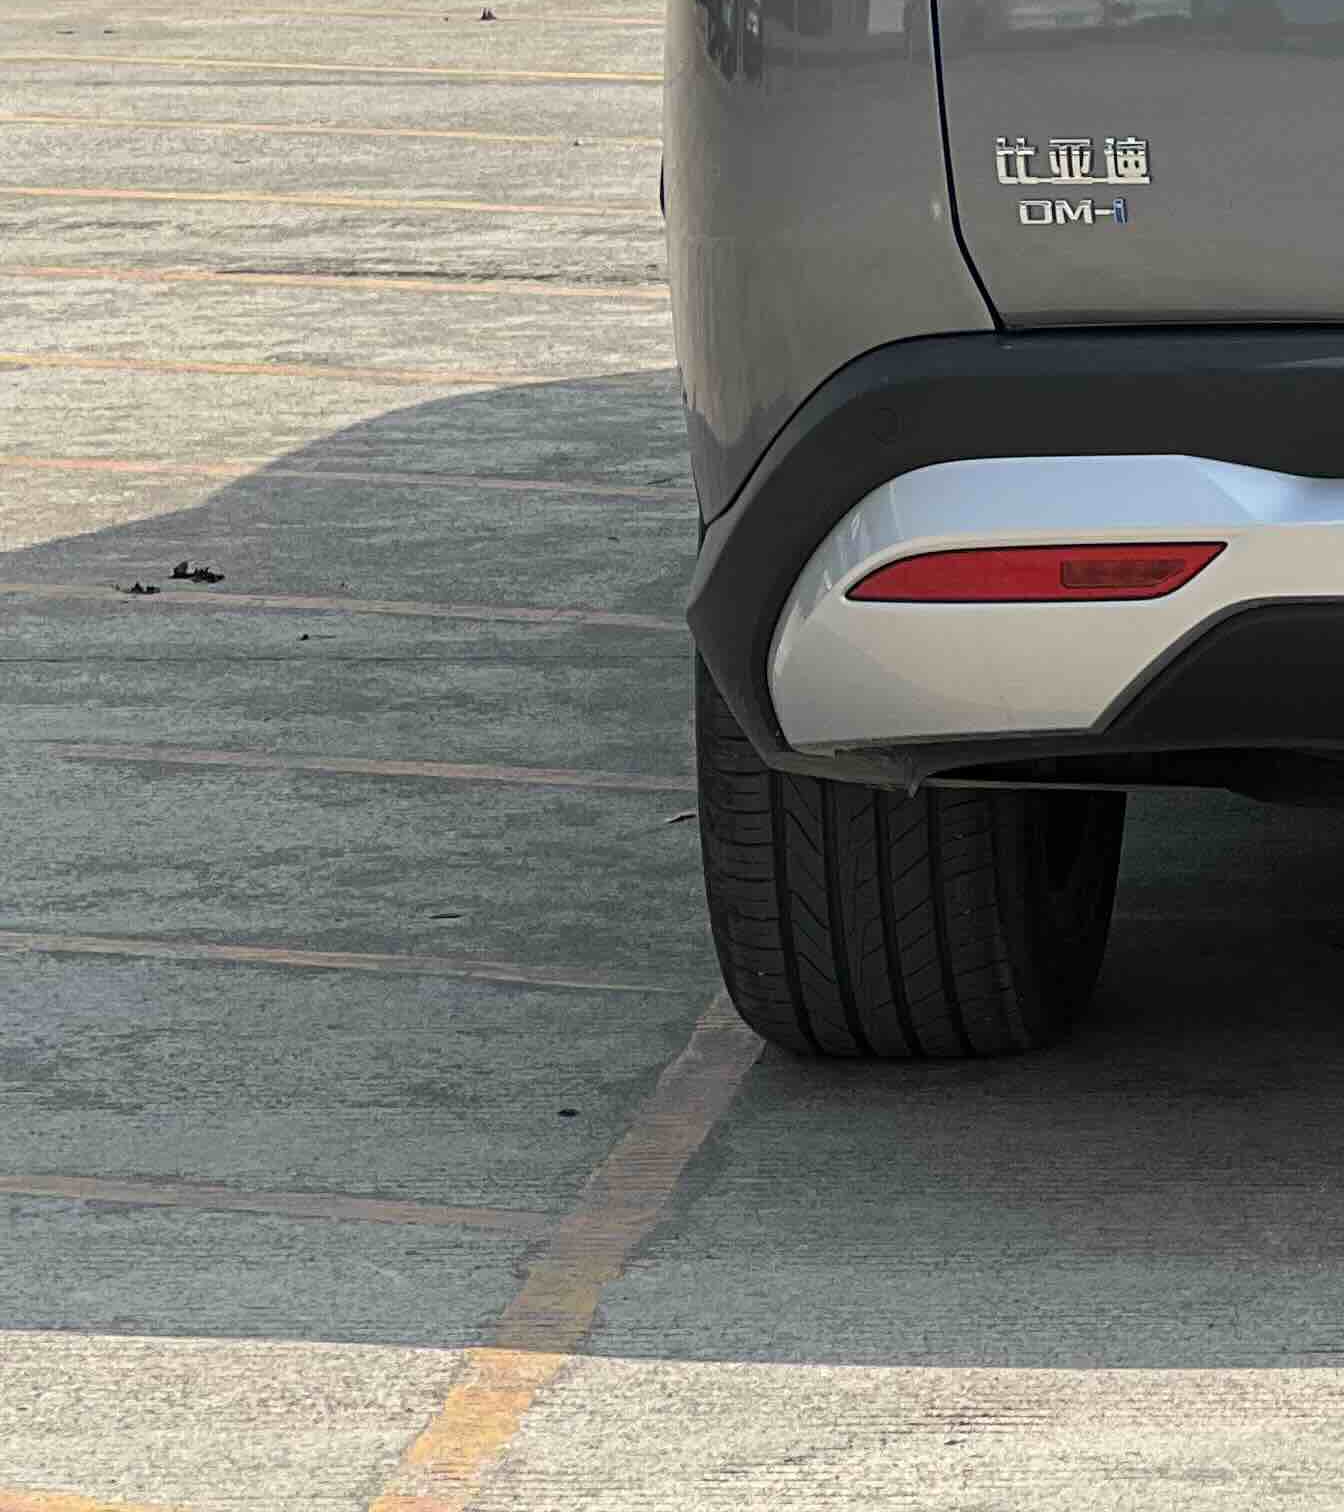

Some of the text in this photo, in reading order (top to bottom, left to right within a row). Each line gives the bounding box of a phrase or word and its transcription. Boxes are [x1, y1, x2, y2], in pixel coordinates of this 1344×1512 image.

[995, 136, 1151, 185] 比亚迪
[1018, 198, 1128, 225] DM-i
